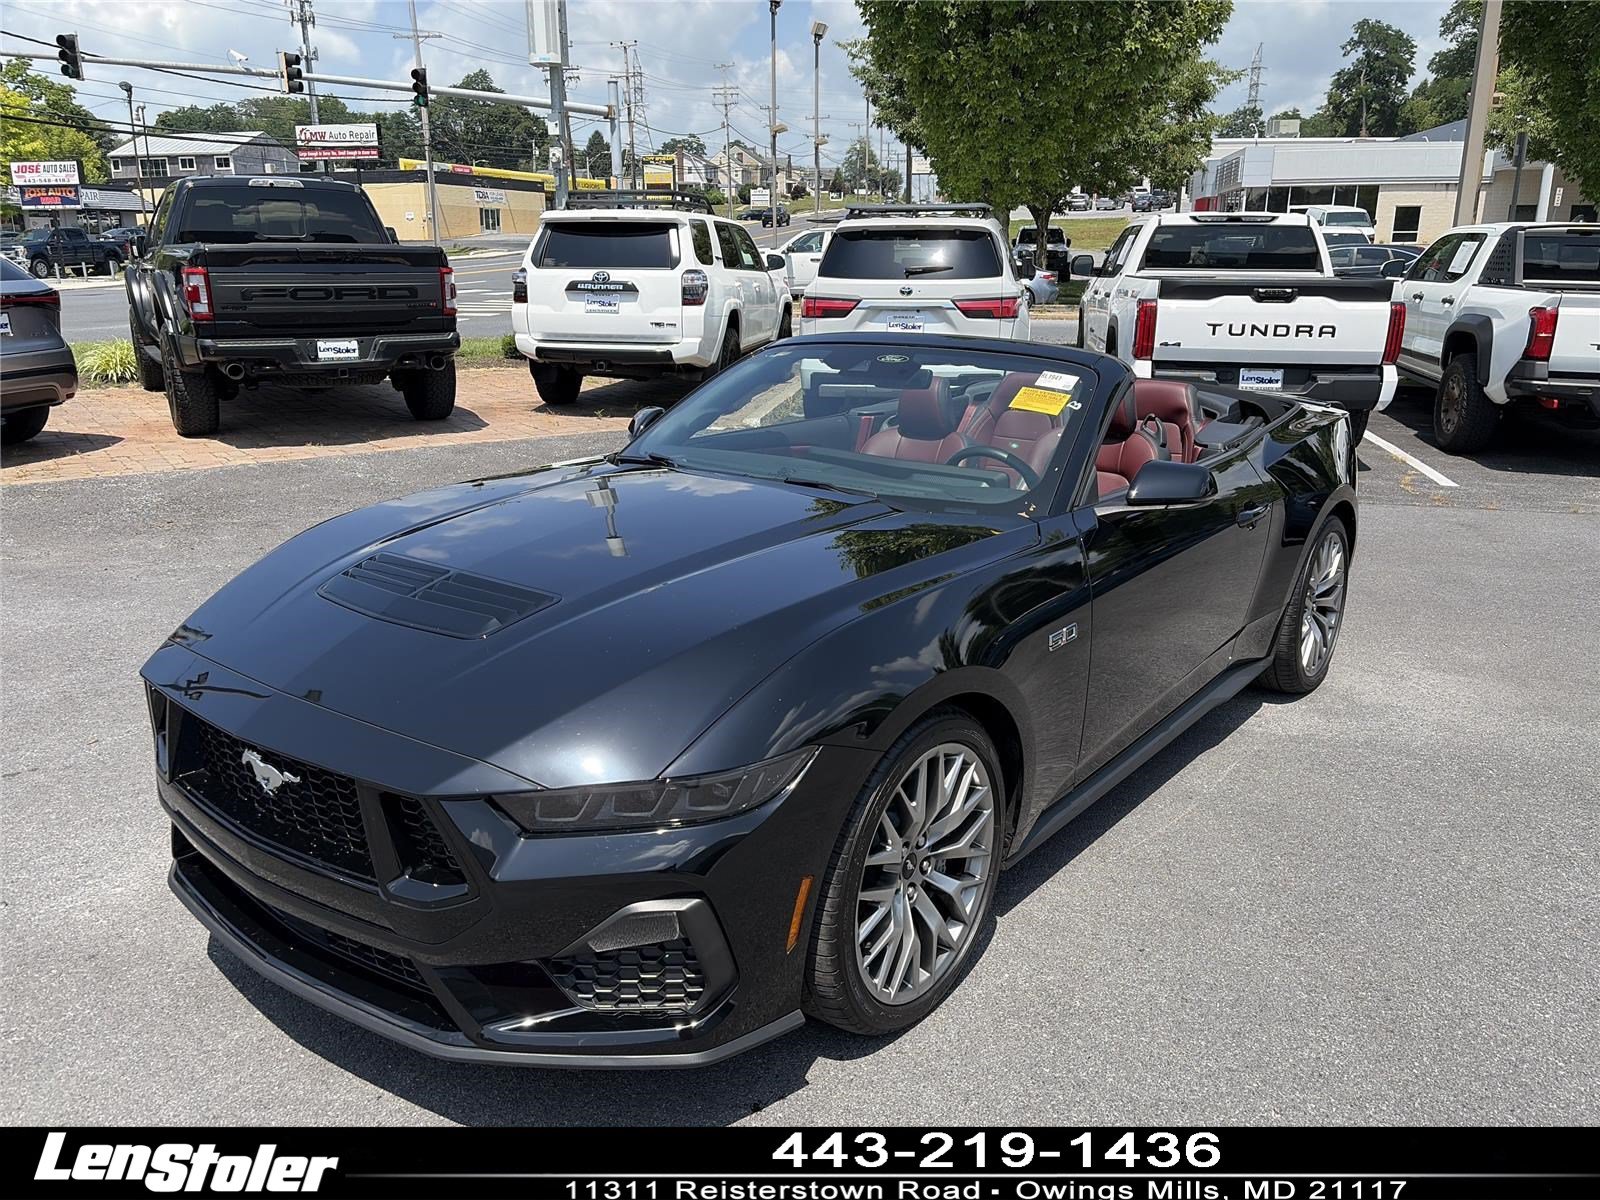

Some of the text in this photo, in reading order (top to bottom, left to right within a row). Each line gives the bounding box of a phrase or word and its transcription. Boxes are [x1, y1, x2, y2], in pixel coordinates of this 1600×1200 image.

[329, 131, 347, 140] Auto
[349, 130, 375, 141] Repair
[14, 163, 76, 174] JOSÉ AUTO SALES
[240, 286, 418, 301] FORD
[1207, 322, 1337, 338] TUNDRA
